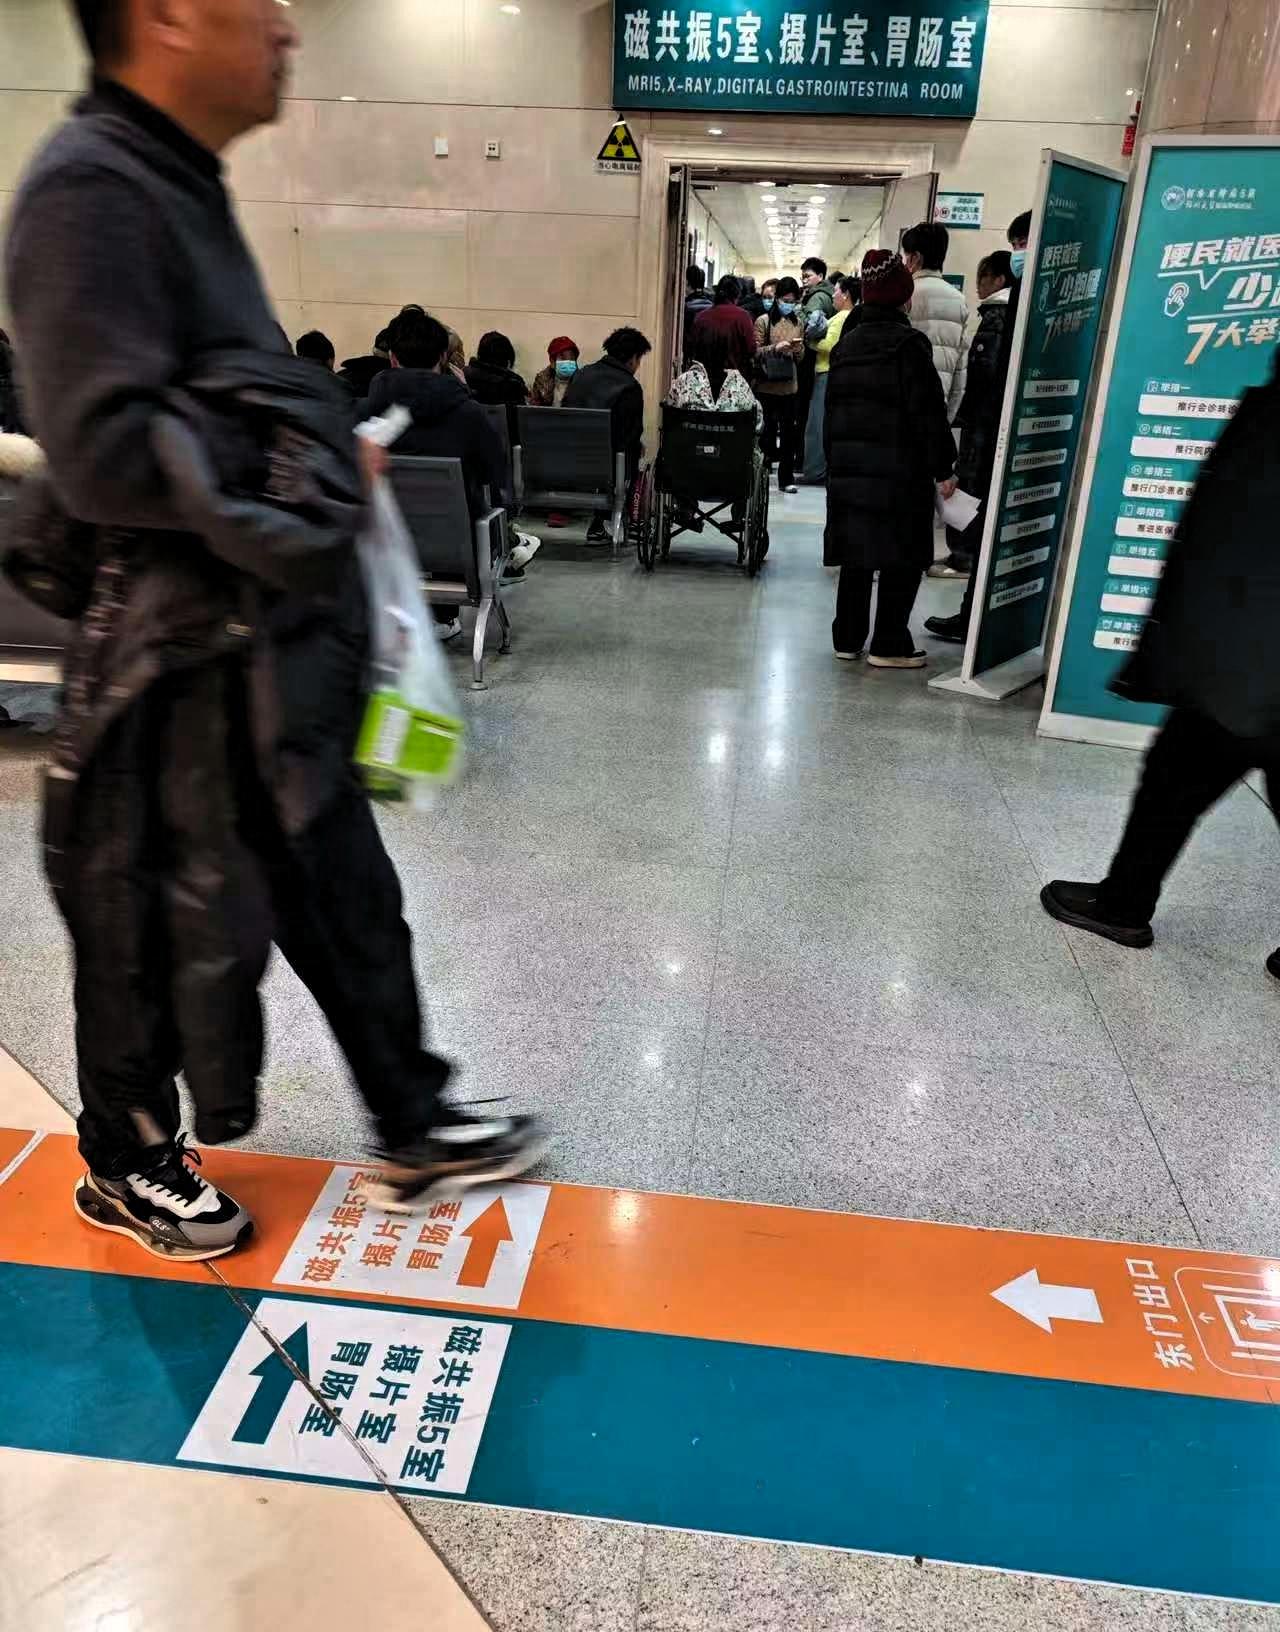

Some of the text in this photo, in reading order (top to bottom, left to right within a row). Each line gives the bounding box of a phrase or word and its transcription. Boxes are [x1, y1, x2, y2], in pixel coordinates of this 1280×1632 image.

[624, 9, 977, 69] 磁共振5室、摄片室、胃肠室
[776, 78, 909, 99] GASTROINTESTINA
[920, 82, 964, 100] ROOM
[1160, 233, 1280, 269] 便民就医
[1223, 271, 1280, 311] 少
[1184, 317, 1280, 365] 7大举
[406, 1199, 463, 1270] 胃肠室
[1125, 1257, 1196, 1372] 东门出口
[299, 1339, 373, 1439] 胃肠室
[354, 1343, 425, 1445] 摄片室
[400, 1324, 485, 1484] 磁共振5室
